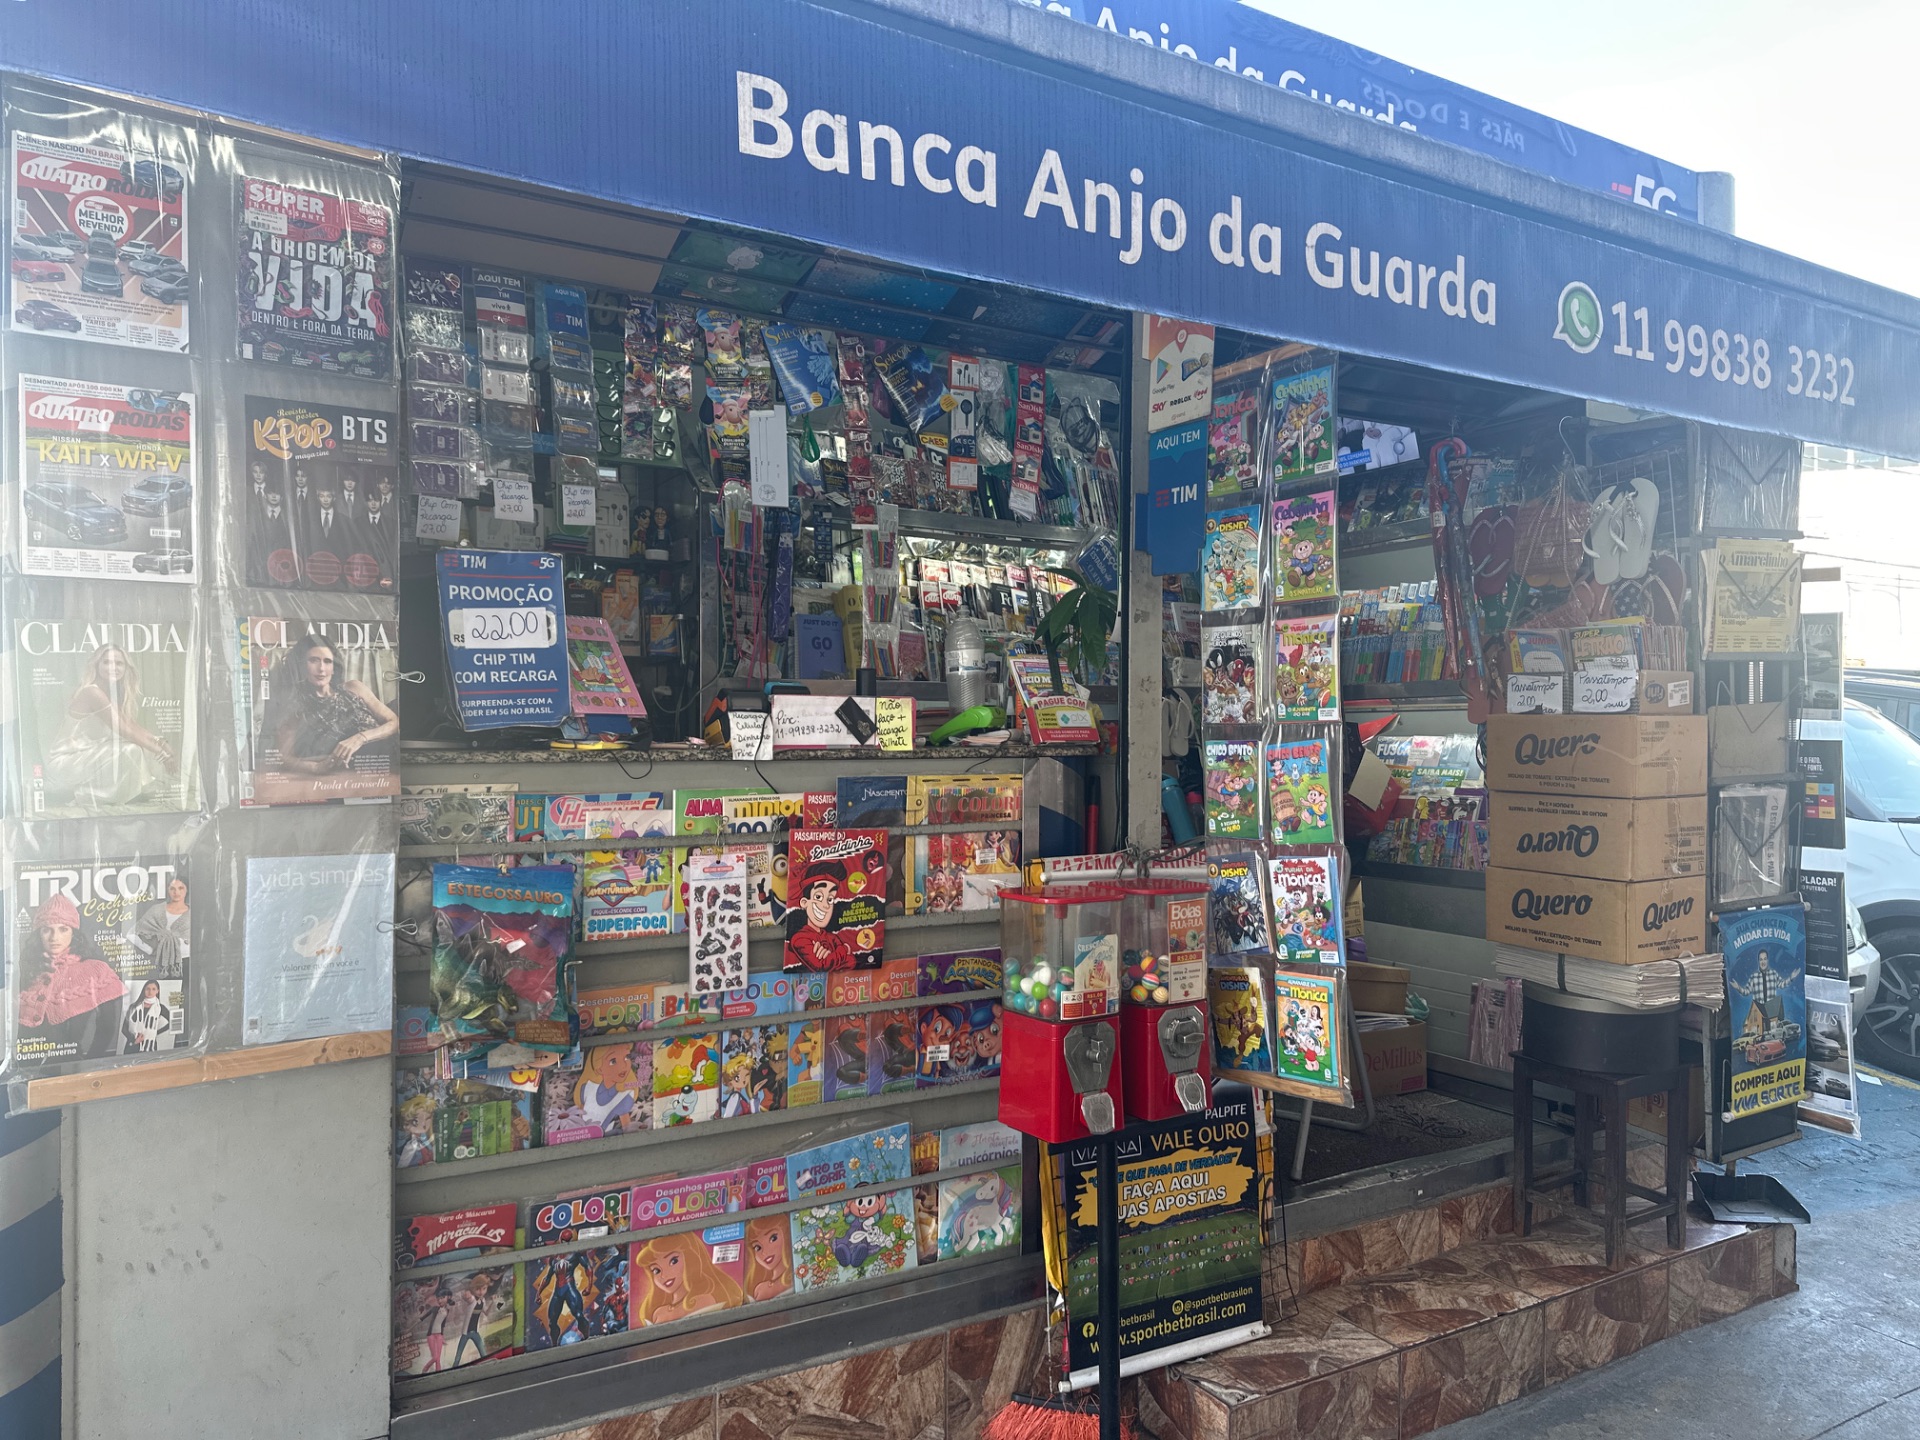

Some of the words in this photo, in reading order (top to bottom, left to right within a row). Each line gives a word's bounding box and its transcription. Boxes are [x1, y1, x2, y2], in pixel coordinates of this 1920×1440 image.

[49, 140, 85, 153] NASCIDO
[85, 147, 98, 156] NO
[99, 150, 126, 162] BRASIL
[249, 183, 324, 216] SUPER
[735, 70, 1000, 209] Banca
[1022, 148, 1189, 265] Anjo
[1208, 194, 1284, 277] da
[1304, 221, 1499, 326] Guarda
[78, 208, 125, 225] MELHOR
[78, 218, 124, 234] REVENDA
[252, 232, 263, 251] A
[271, 235, 345, 267] ORIGEM
[353, 251, 376, 272] DA
[477, 273, 500, 283] AQUI
[503, 276, 521, 287] TEM
[252, 310, 289, 328] DENTRO
[293, 318, 298, 329] E
[303, 319, 326, 334] FORA
[331, 324, 342, 336] DA
[347, 327, 375, 341] TERRA
[566, 315, 583, 328] TIM
[1612, 301, 1655, 362] 11
[1664, 319, 1772, 389] 99838
[1786, 345, 1855, 406] 3232
[1152, 387, 1166, 395] Google
[1167, 383, 1175, 391] Play
[1275, 377, 1329, 399] Cebolinha
[1018, 401, 1044, 414] SanDisk
[1152, 401, 1167, 413] SKY
[1169, 396, 1192, 406] ROBLOX
[28, 400, 115, 432] QUATRO
[113, 410, 186, 431] RODAS
[342, 415, 388, 444] BTS
[52, 435, 81, 444] NISSAN
[1156, 434, 1180, 451] AQUI
[1181, 429, 1200, 444] TEM
[39, 442, 96, 466] KAIT
[115, 448, 182, 474] WR-V
[295, 450, 330, 461] magazine
[1171, 483, 1198, 505] TIM
[1274, 500, 1329, 521] Cebolinha
[1219, 521, 1249, 532] DISNEY
[461, 555, 487, 569] TIM
[539, 557, 555, 569] 5G
[1729, 552, 1788, 568] Amarelinho
[448, 583, 553, 606] PROMOÇÃO
[471, 611, 539, 641] 22,00
[1806, 624, 1834, 636] PLUS
[20, 621, 188, 656] CLAUDIA
[1213, 630, 1243, 639] PEQUENOS
[1573, 629, 1600, 639] SUPER
[811, 636, 832, 650] GO
[473, 653, 506, 665] CHIP
[509, 653, 536, 665] TIM
[455, 671, 486, 684] COM
[490, 670, 558, 682] RECARGA
[461, 698, 526, 707] SURPREENDA-SE
[1037, 698, 1065, 708] PAGUE
[1067, 698, 1086, 709] COM
[1206, 744, 1227, 756] CHICO
[1228, 743, 1253, 756] BENTO
[1267, 748, 1290, 761] CHICO
[1292, 743, 1322, 759] BENTO
[1515, 733, 1600, 765] Quero
[1416, 768, 1441, 777] SAIBA
[1442, 768, 1464, 777] MAIS!
[1807, 764, 1824, 772] FONTE.
[313, 779, 342, 791] Paola
[344, 778, 390, 790] Carosella
[728, 822, 767, 833] 100
[1517, 824, 1599, 858] Quero
[260, 868, 304, 888] vida
[309, 866, 385, 887] simples
[1220, 868, 1248, 878] DISNEY
[1277, 873, 1322, 888] Mônica
[20, 865, 175, 908] TRICOT
[447, 882, 564, 905] ESTEGOSSAURO
[587, 886, 638, 897] AVENTUREIROS
[634, 906, 646, 914] COM
[843, 906, 875, 916] ADESIVOS
[851, 901, 865, 909] COM
[1511, 888, 1593, 921] Quero
[839, 913, 879, 924] DIVERTIDOS!
[1171, 905, 1202, 920] Bolas
[1642, 897, 1695, 932] Quero
[587, 915, 668, 932] SUPERFOCA
[1170, 918, 1204, 930] PULA-PULA
[1736, 923, 1749, 934] SUA
[1750, 919, 1777, 930] CHANCE
[1777, 919, 1787, 929] DE
[1505, 925, 1519, 933] MOLHO
[1528, 928, 1547, 937] TOMATE
[1582, 937, 1602, 947] TOMATE
[1733, 930, 1763, 949] MUDAR
[1763, 929, 1773, 938] DE
[1773, 928, 1791, 943] VIDA
[120, 959, 151, 967] Maneiras
[957, 959, 992, 968] PINTANDO
[1176, 953, 1197, 962] R$2.00
[1821, 965, 1840, 973] PLACAR
[1220, 981, 1250, 991] DISNEY
[579, 994, 626, 1006] Desenhos
[628, 993, 649, 1004] para
[1290, 986, 1328, 1002] Mônica
[1811, 1011, 1839, 1026] PLUS
[17, 1041, 56, 1053] Fashion
[1734, 1069, 1774, 1092] COMPRE
[1776, 1065, 1801, 1082] AQUI
[1204, 1104, 1247, 1120] PALPITE
[556, 1129, 590, 1138] ATIVIDADES
[1150, 1129, 1193, 1152] VALE
[1198, 1121, 1249, 1145] OURO
[833, 1161, 844, 1169] DE
[958, 1148, 1019, 1168] unicórnios
[1126, 1167, 1147, 1180] QUE
[1147, 1162, 1173, 1178] PAGA
[1174, 1160, 1188, 1173] DE
[655, 1183, 702, 1198] Desenhos
[704, 1179, 725, 1191] para
[1123, 1177, 1165, 1202] FAÇA
[1170, 1172, 1210, 1190] AQUI
[638, 1185, 743, 1221] COLORIR
[763, 1195, 777, 1203] BELA
[439, 1214, 454, 1223] Livro
[465, 1208, 496, 1219] Máscaras
[536, 1192, 630, 1232] COLORI
[657, 1218, 662, 1226] A
[662, 1215, 680, 1225] BELA
[682, 1208, 724, 1221] ADORMECIDA
